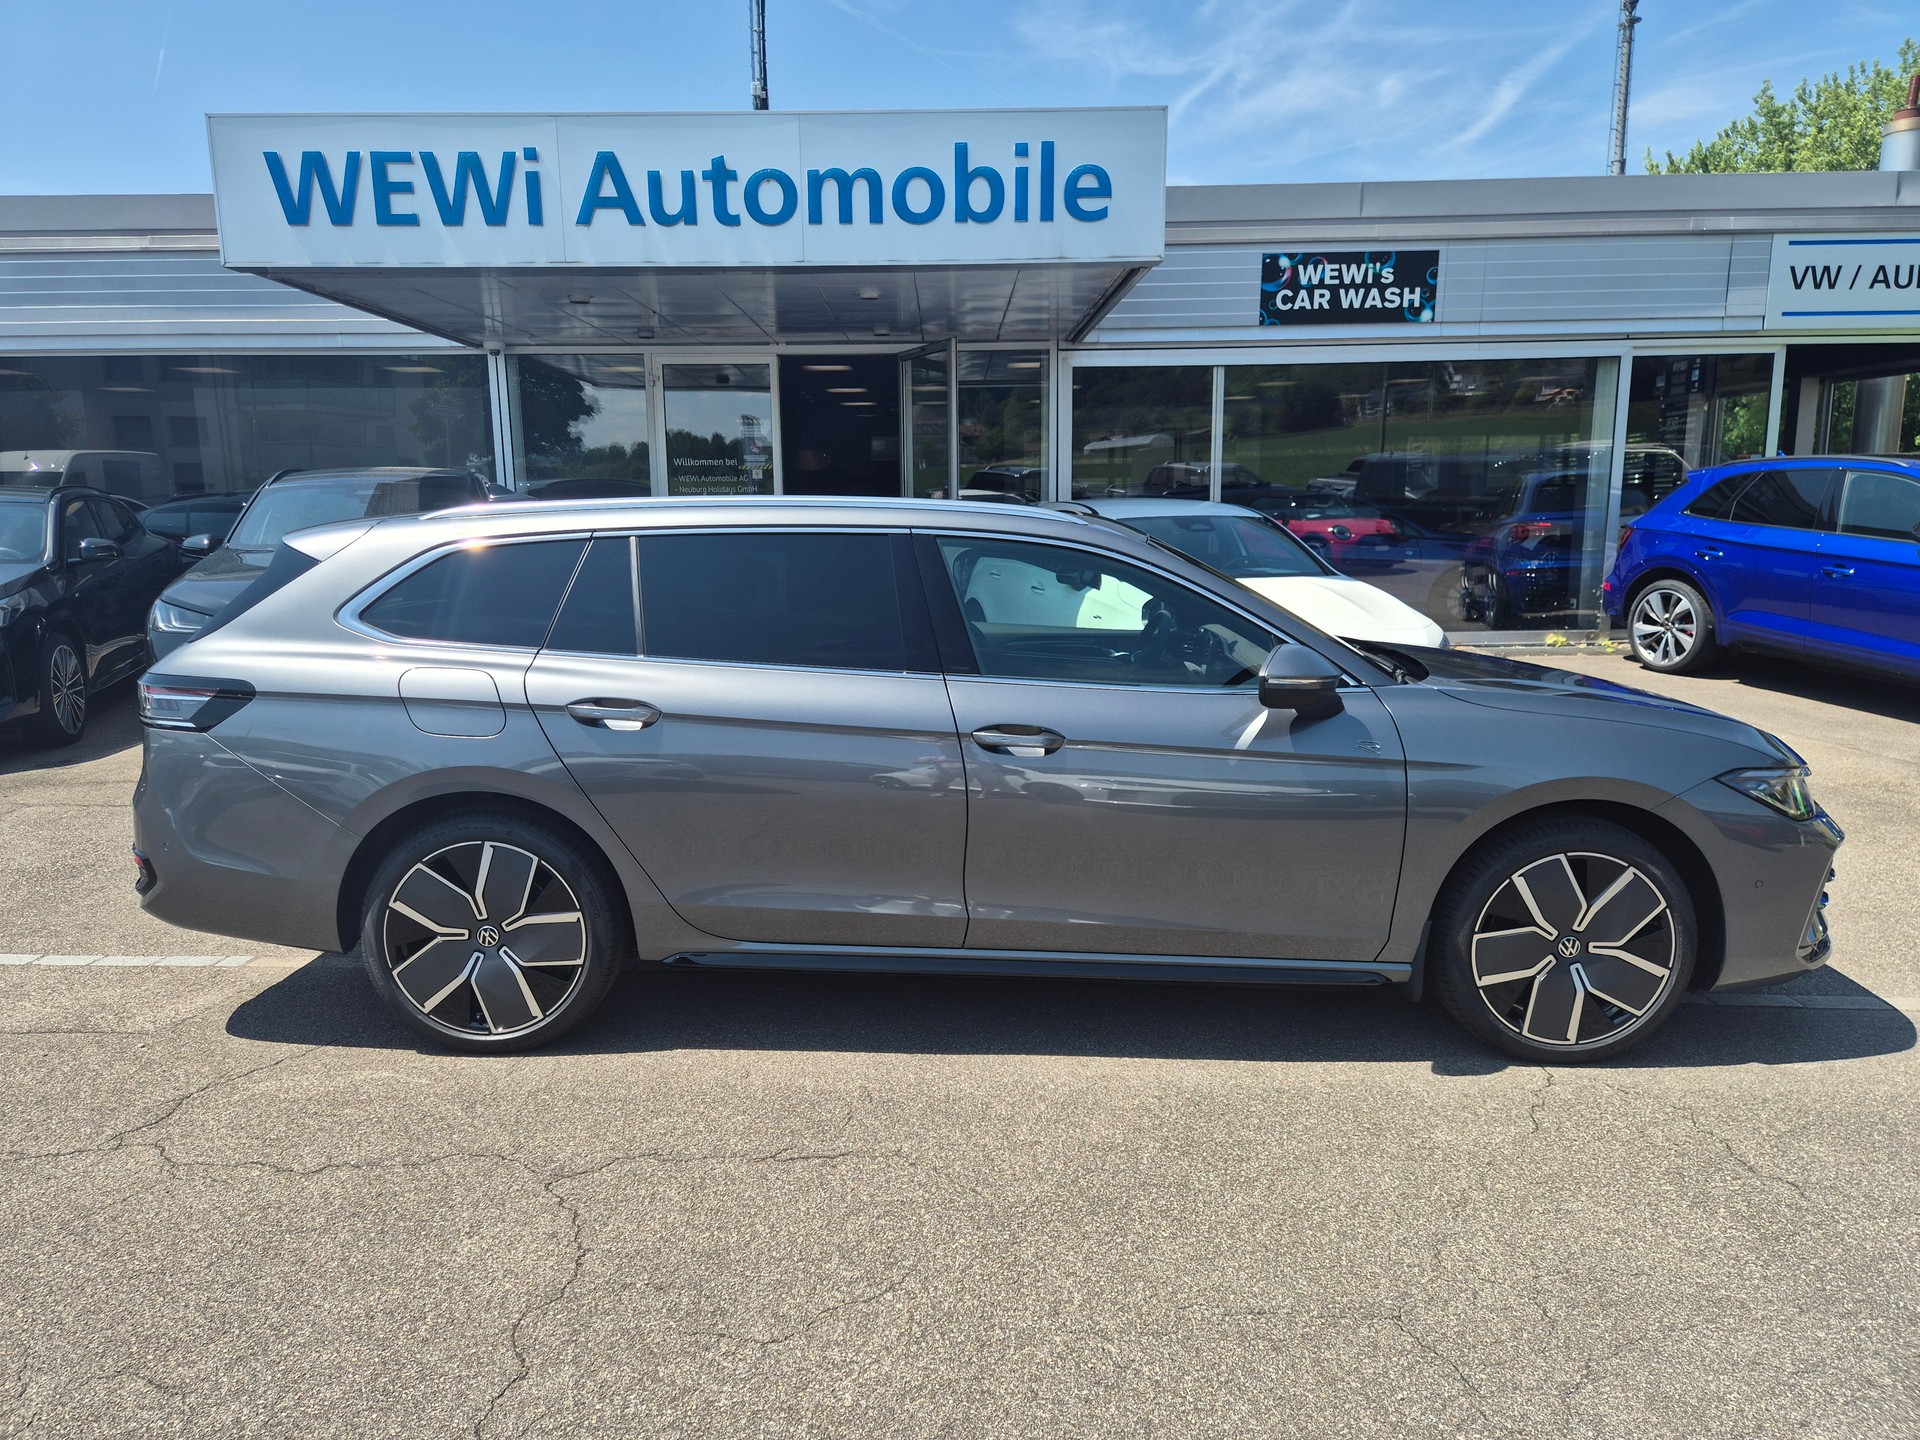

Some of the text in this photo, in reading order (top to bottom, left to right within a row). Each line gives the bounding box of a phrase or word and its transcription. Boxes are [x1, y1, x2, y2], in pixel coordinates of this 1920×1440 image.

[262, 140, 1112, 227] WEWi Automobile
[1297, 262, 1395, 285] WEWi's
[1789, 264, 1843, 290] VW
[1868, 264, 1920, 290] AU
[1275, 286, 1422, 311] CAR WASH
[673, 457, 724, 466] Willkommen
[725, 457, 738, 466] bei
[701, 474, 738, 482] Automobile
[739, 474, 749, 482] AG
[679, 486, 707, 495] Neuburg
[737, 485, 758, 493] GmbH
